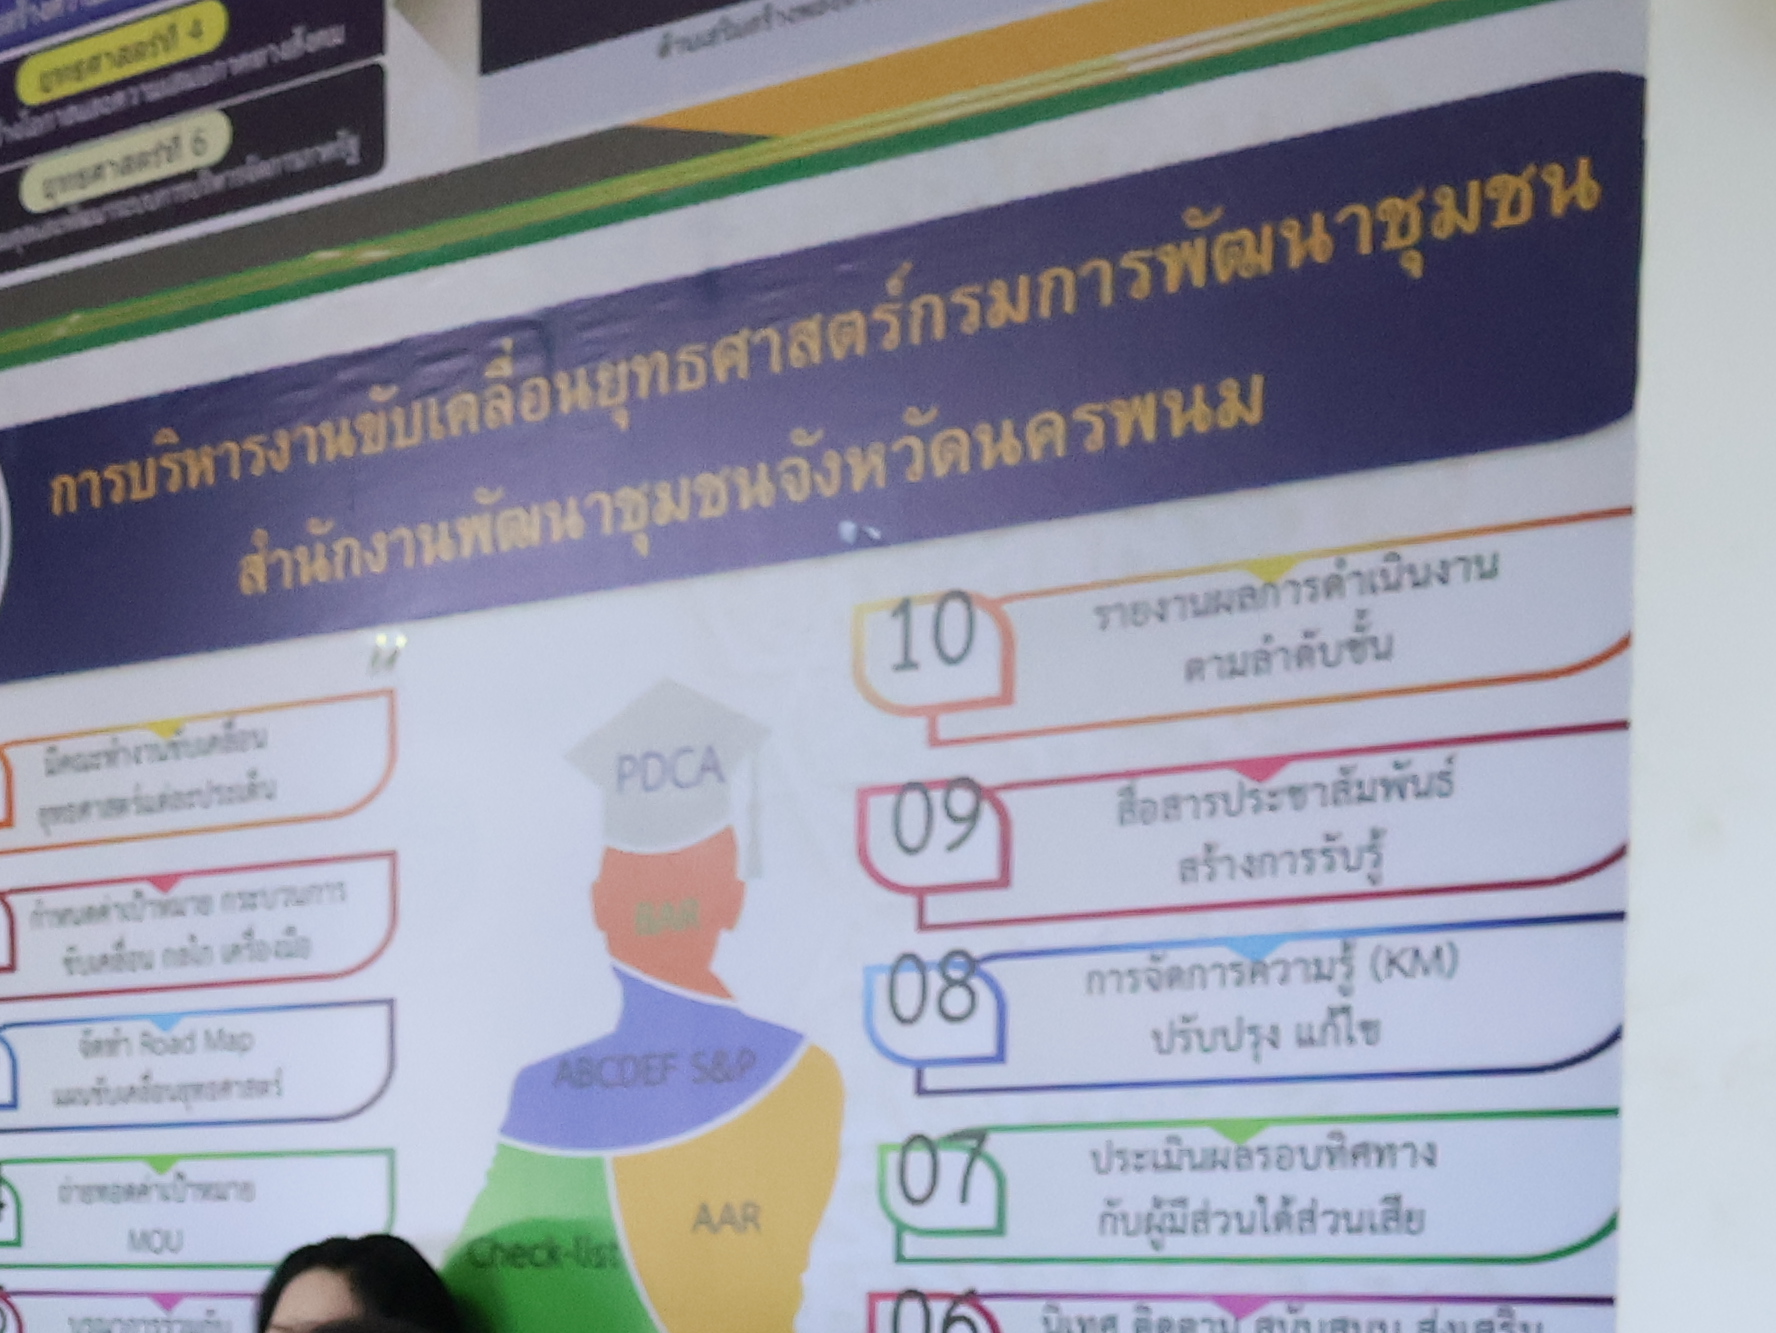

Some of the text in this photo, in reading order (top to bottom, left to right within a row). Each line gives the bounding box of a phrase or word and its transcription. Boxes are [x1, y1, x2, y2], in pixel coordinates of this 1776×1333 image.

[50, 153, 1602, 516] การบริหารงานขับเคลื่อนยุทธศาสตร์กรมการพัฒนาชุมชน
[237, 371, 1267, 597] สำนักงานพัฒนาชุมชนจังหวัดนครพนม
[890, 546, 1502, 672] 10 รายงานผลการดำเนินงาน
[1183, 608, 1396, 684] ตามลำดับชั้น
[615, 745, 727, 795] PDCA
[891, 756, 1457, 856] 09 สื่อสารประชาสัมพันธ์
[1177, 826, 1388, 887] สร้างการรับรู้
[886, 939, 1460, 1026] 08 การจัดการความรู้ (KM)
[553, 1046, 757, 1091] ABCDEF S&P
[1151, 1005, 1382, 1066] ปรับปรุง แก้ไข
[897, 1129, 989, 1208] 07
[691, 1200, 764, 1238] AAR
[1096, 1193, 1428, 1252] กับผู้มีส่วนได้ส่วนเสีย
